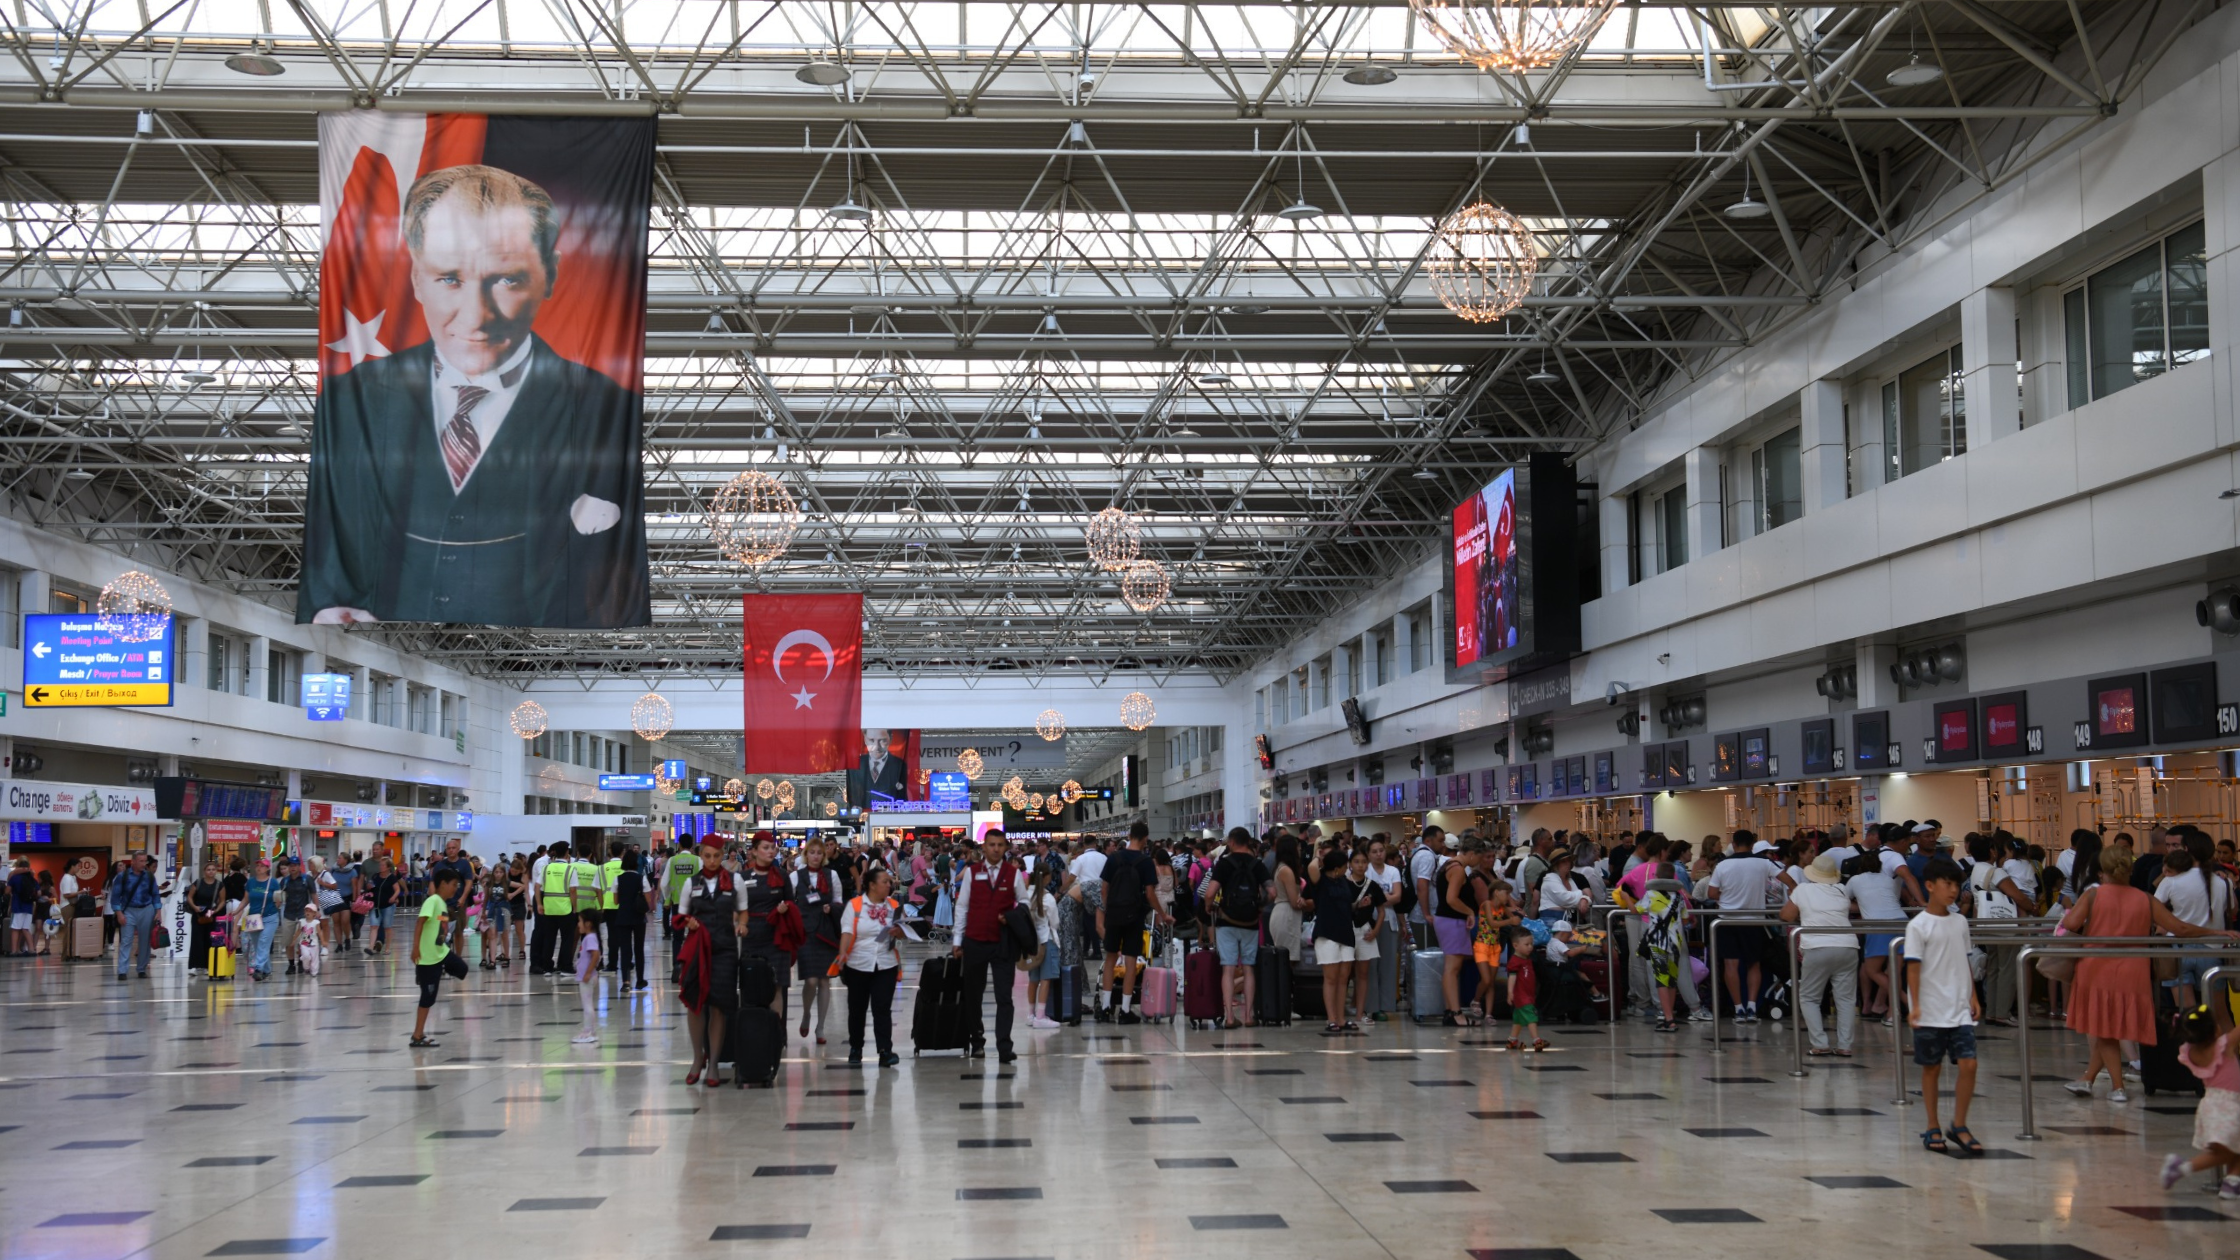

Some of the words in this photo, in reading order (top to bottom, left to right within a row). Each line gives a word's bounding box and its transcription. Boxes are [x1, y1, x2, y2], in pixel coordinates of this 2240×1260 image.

[61, 622, 92, 632] Buluşma
[61, 636, 91, 646] Meeting
[94, 636, 113, 645] Point
[60, 654, 95, 664] Exchange
[96, 653, 119, 662] Office
[127, 653, 144, 662] ATM
[60, 669, 84, 679] Mescit
[94, 669, 118, 680] Prayer
[121, 669, 142, 678] Room
[60, 690, 78, 700] Çıkış
[86, 689, 99, 698] Exit
[108, 689, 137, 698] Выход
[1520, 682, 1545, 705] CHECK-IN
[2217, 706, 2237, 734] 150
[2027, 729, 2042, 752] 148
[2075, 724, 2090, 747] 149
[1833, 749, 1844, 768] 145
[1888, 745, 1900, 765] 146
[1924, 740, 1935, 760] 147
[10, 787, 50, 814] Change
[57, 792, 74, 802] обмен
[108, 795, 130, 813] Döviz
[53, 803, 74, 813] валюты
[173, 901, 187, 953] wispotter
